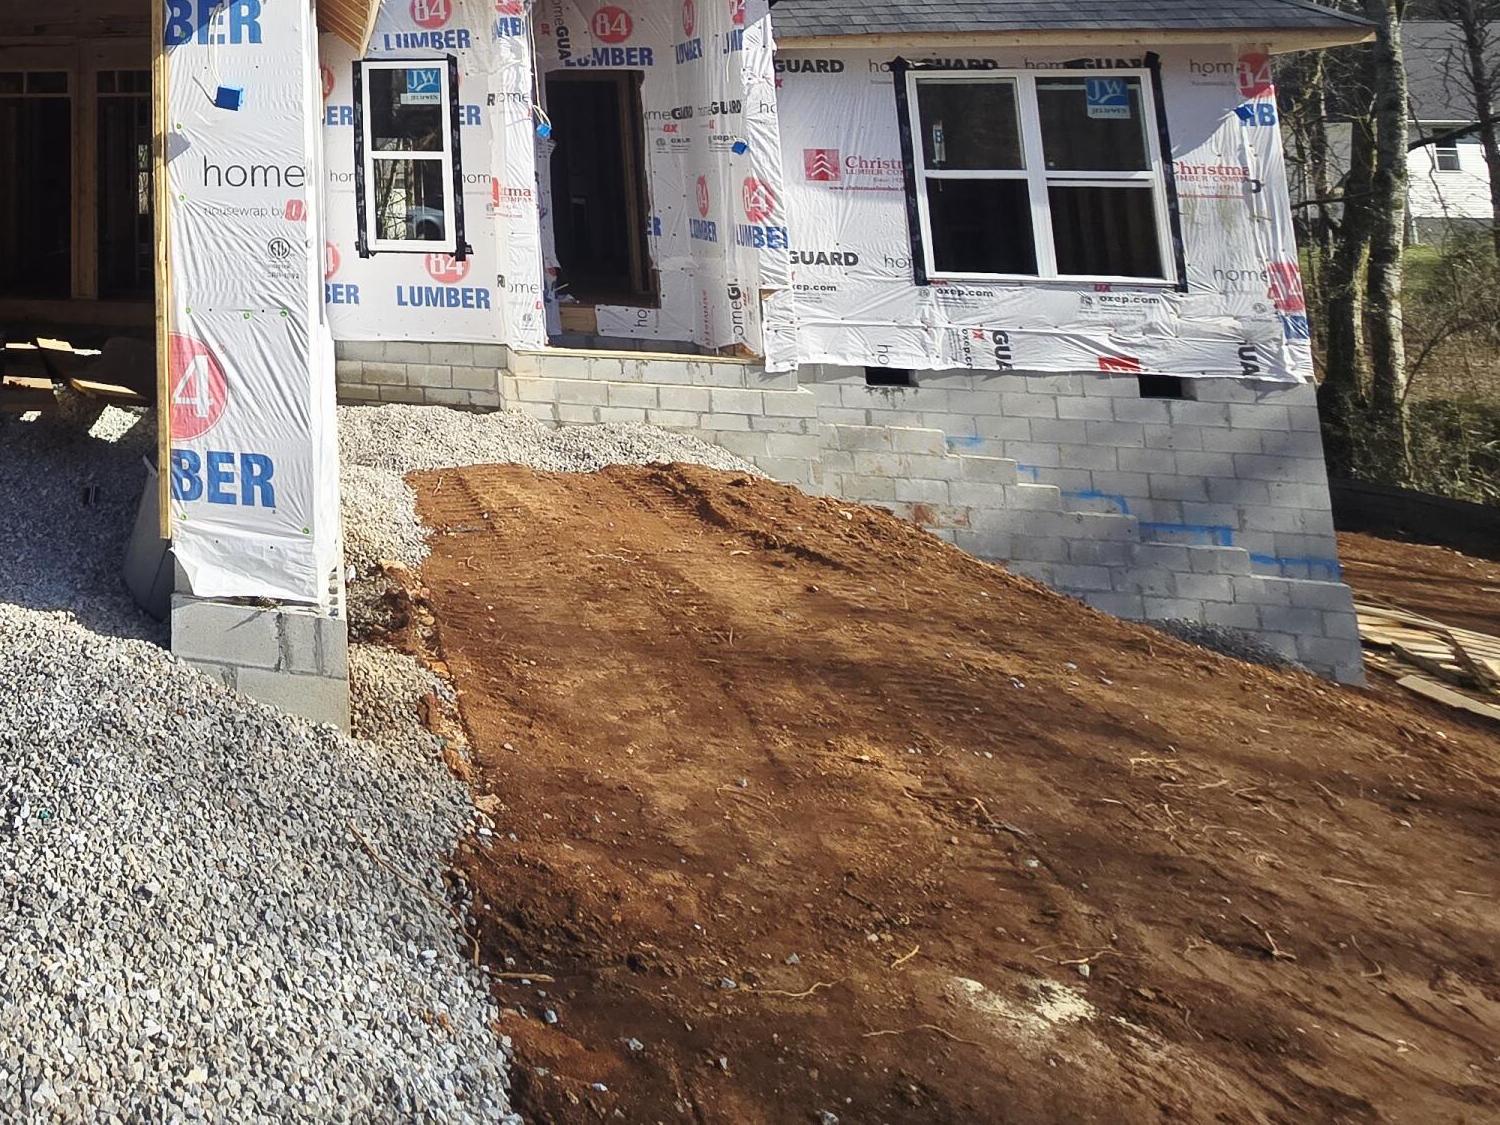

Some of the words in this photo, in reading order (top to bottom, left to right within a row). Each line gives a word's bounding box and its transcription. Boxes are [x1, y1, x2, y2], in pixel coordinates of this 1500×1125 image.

[596, 12, 629, 36] 84
[775, 59, 845, 74] GUARD
[408, 70, 438, 89] JW
[1088, 79, 1125, 101] JW
[845, 156, 903, 169] Christ
[789, 252, 859, 267] GUARD
[325, 284, 360, 305] BER
[396, 285, 491, 310] LUMBER
[936, 288, 994, 299] oxep.com
[1099, 295, 1160, 305] oxep.com
[172, 355, 213, 418] 4
[171, 449, 277, 508] BER
